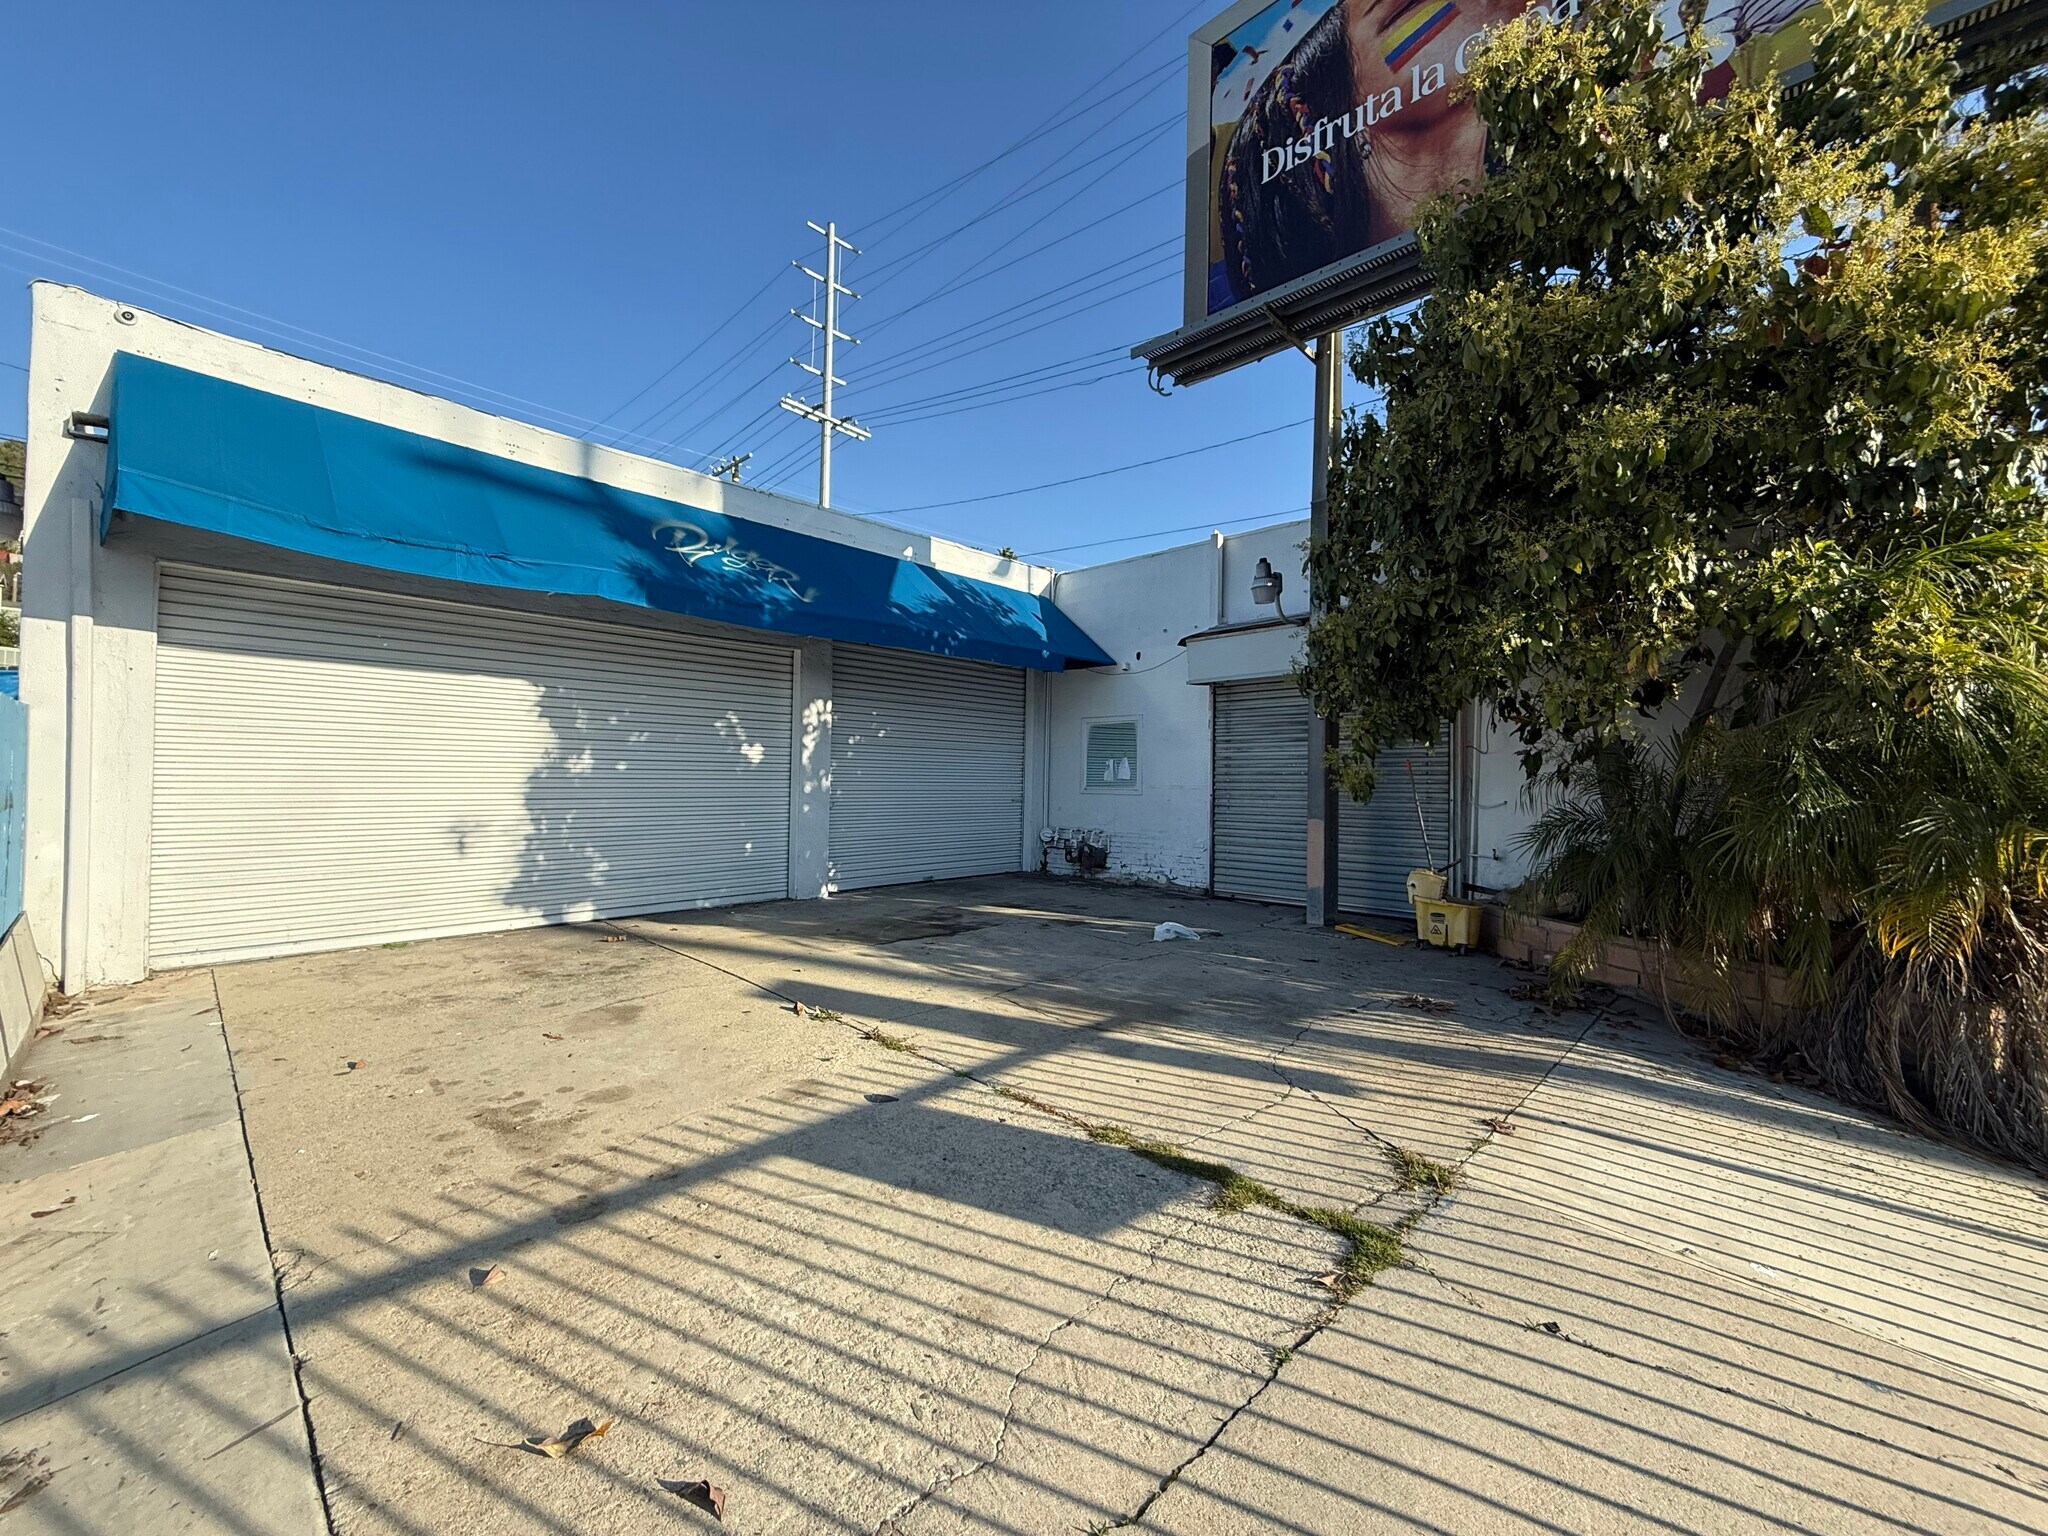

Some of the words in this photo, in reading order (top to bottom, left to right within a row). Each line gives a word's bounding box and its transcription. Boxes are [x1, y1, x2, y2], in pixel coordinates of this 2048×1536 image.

[1261, 87, 1402, 184] Disfruta
[1411, 63, 1446, 102] la
[1454, 0, 1580, 74] Cpa
